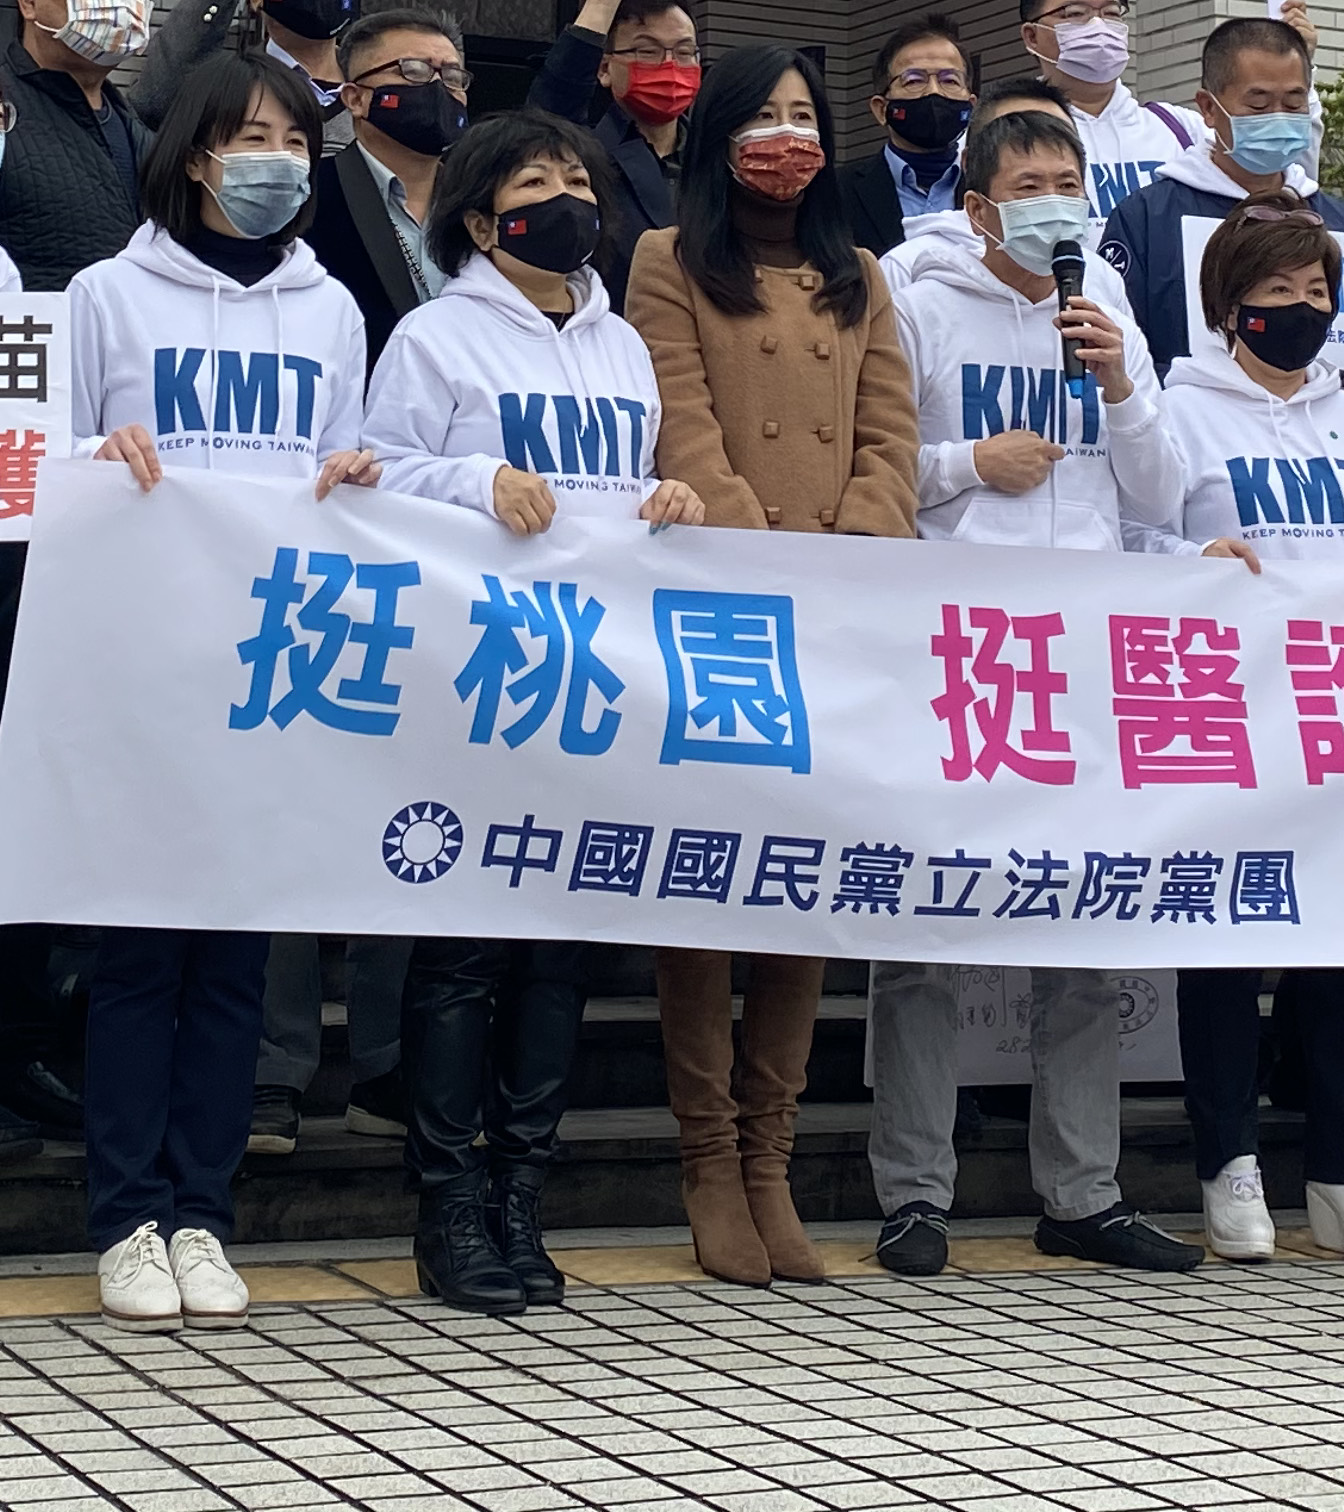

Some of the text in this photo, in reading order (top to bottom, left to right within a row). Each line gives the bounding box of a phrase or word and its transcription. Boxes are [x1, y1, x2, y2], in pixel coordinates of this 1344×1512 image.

[155, 348, 323, 440] KMT
[498, 392, 646, 480] KMT
[157, 437, 195, 452] KEEP
[1066, 447, 1106, 458] AIWAN
[1242, 528, 1276, 541] KEEP
[1281, 527, 1335, 539] MOVING
[228, 546, 812, 775] 挺桃園
[480, 813, 1302, 926] 中國國民黨立法院黨團
